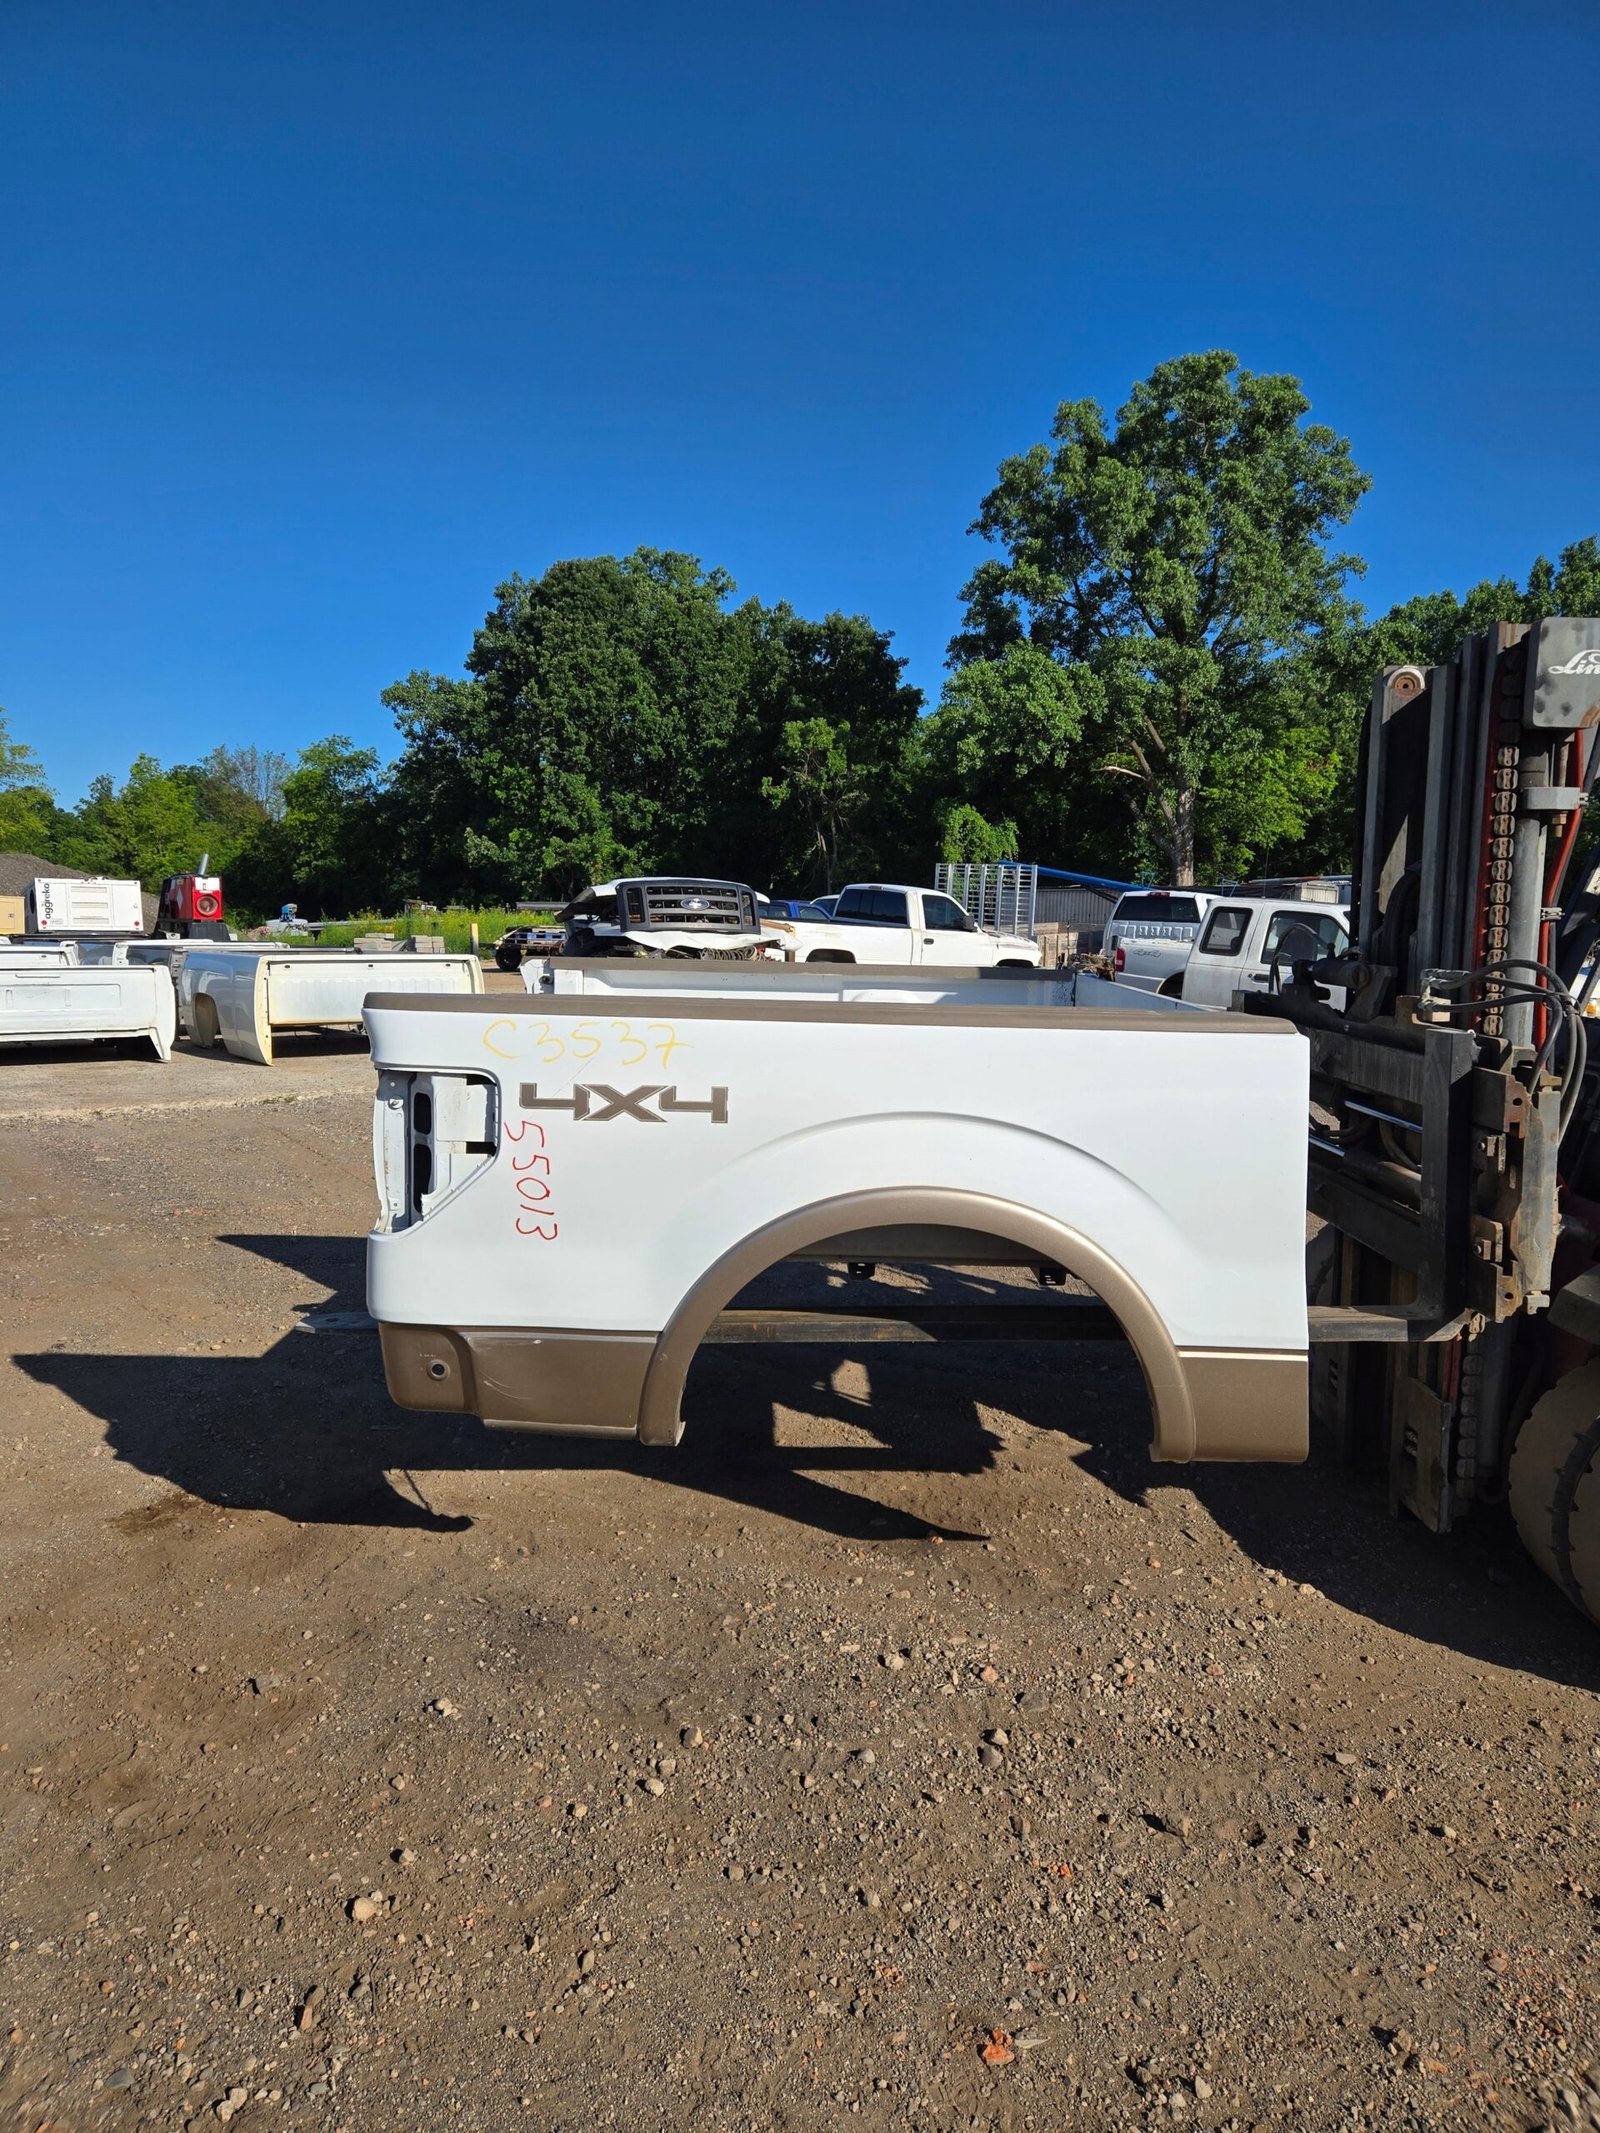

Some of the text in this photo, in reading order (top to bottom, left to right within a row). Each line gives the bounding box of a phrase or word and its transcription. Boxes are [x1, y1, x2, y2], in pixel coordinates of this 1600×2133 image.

[42, 883, 54, 919] aggreko
[483, 1019, 695, 1069] C3537
[504, 1120, 558, 1240] 55013
